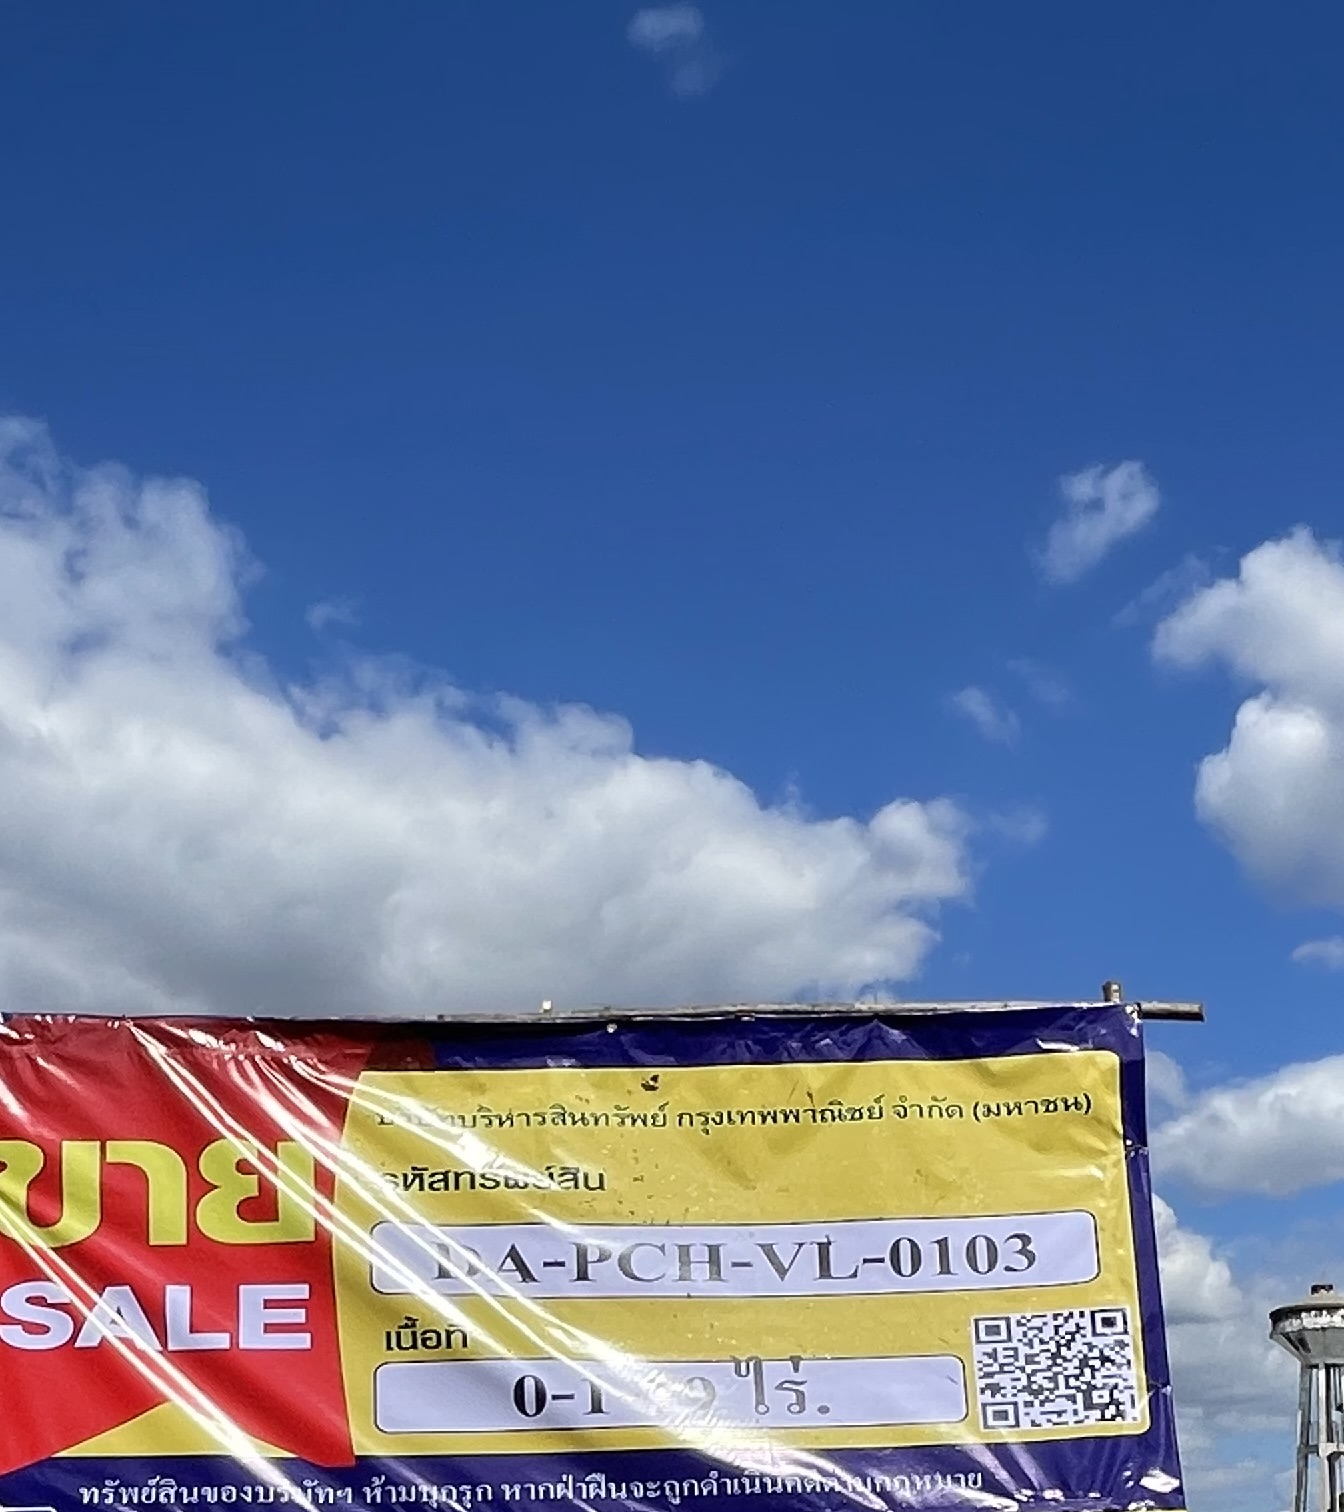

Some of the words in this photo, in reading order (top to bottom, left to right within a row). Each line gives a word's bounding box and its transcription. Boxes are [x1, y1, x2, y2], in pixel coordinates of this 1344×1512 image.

[677, 1093, 885, 1135] กรุงเทพพาณิชย์
[893, 1096, 964, 1121] จำกัด
[972, 1093, 1092, 1123] (มหาชน)
[382, 1165, 606, 1191] รหัสทรพย์สิน
[432, 1231, 1038, 1284] DA-PCH-VL-0103
